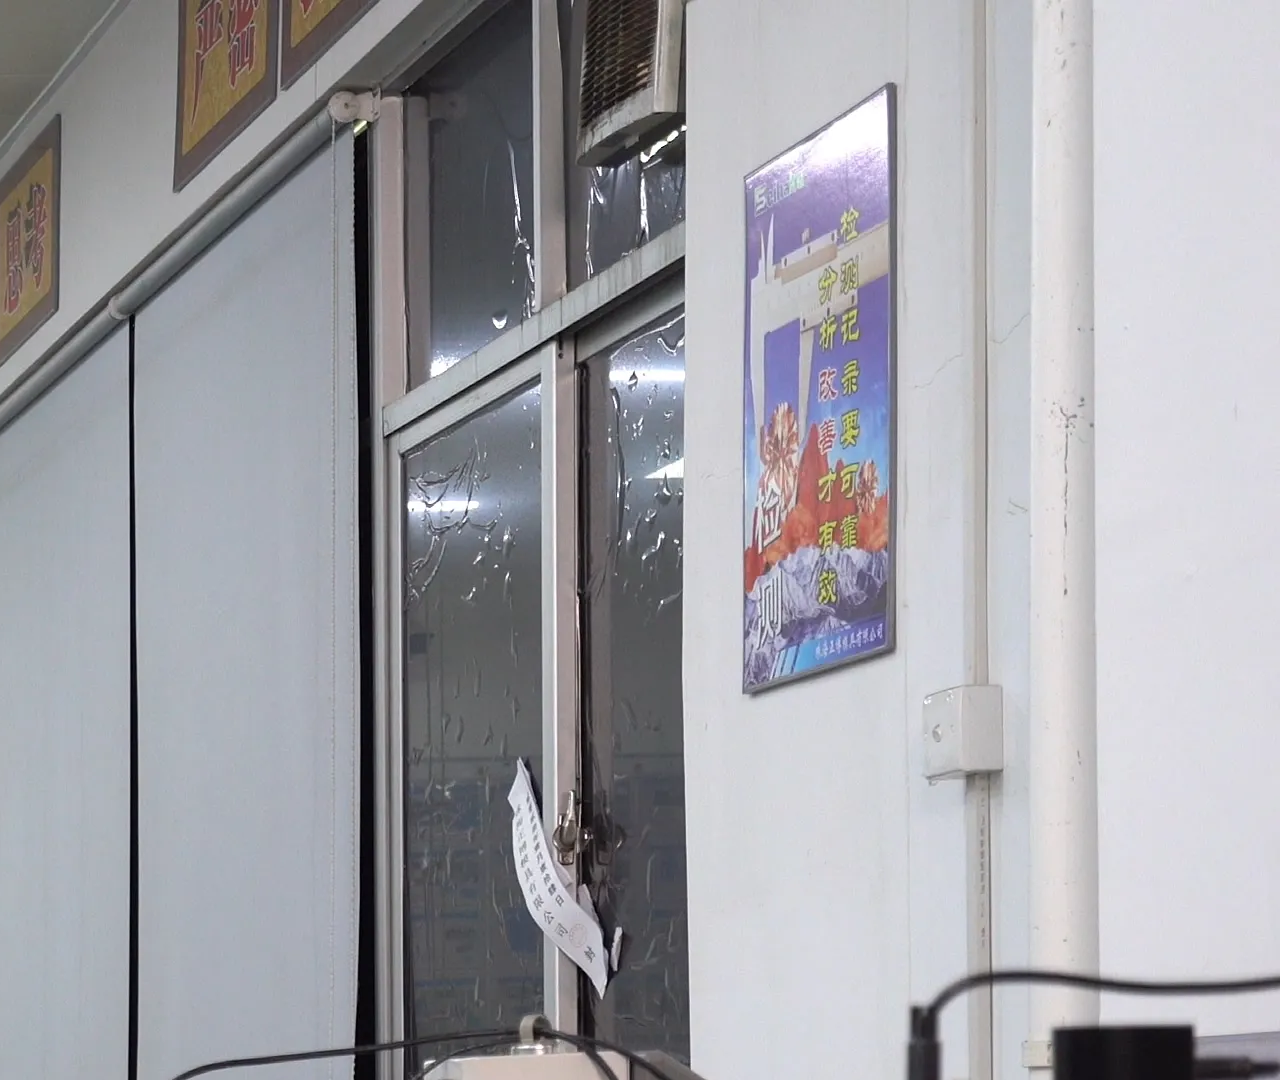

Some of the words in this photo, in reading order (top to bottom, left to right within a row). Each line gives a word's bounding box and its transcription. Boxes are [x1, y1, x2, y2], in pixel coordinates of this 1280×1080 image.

[816, 264, 838, 605] 分析改善才有效
[838, 205, 861, 550] 检测记录要可靠
[755, 477, 784, 651] 检测
